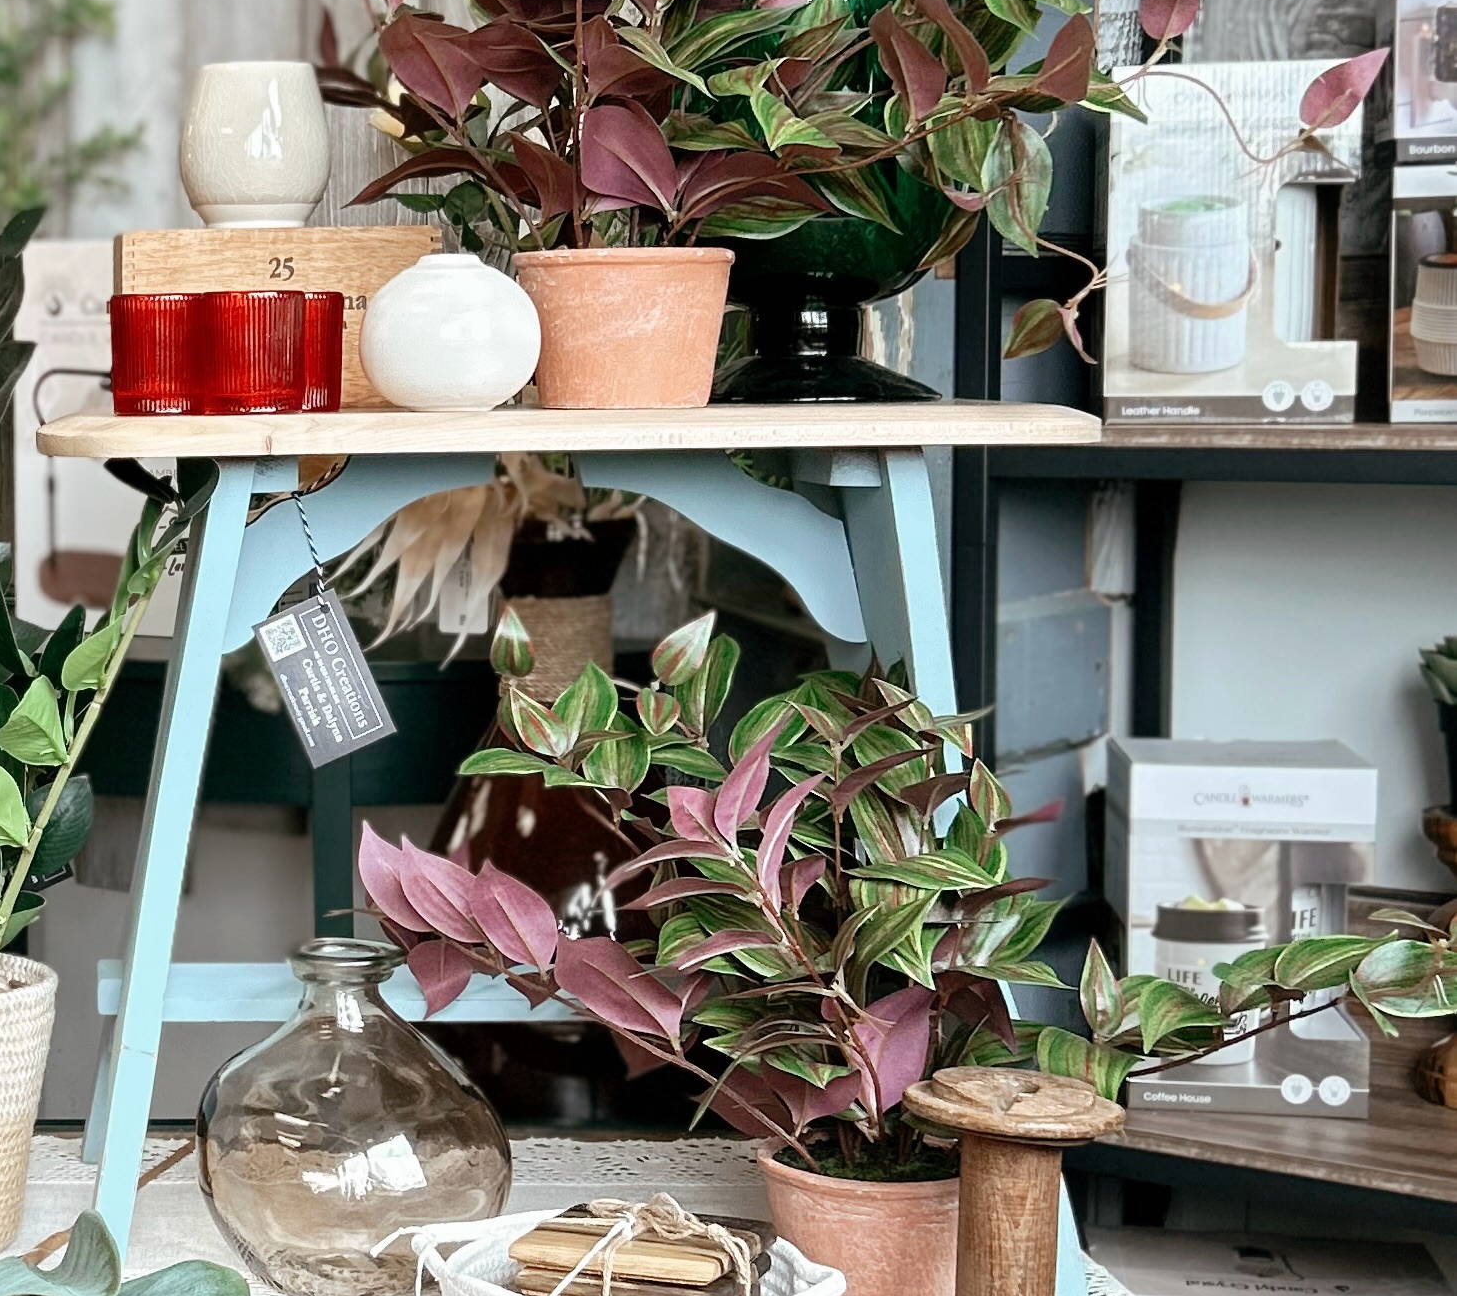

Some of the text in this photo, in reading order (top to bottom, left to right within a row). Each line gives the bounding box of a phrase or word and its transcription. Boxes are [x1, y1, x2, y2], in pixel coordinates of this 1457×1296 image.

[1409, 144, 1456, 155] Bourbon
[268, 256, 296, 282] 25
[1121, 405, 1200, 416] Leather Handle
[311, 613, 339, 655] DHO
[331, 657, 369, 729] Creations
[302, 658, 323, 692] Curtis
[316, 692, 325, 704] &
[1193, 792, 1236, 805] CANDLE
[1292, 906, 1317, 930] IFE
[1167, 967, 1203, 985] LIFE
[1143, 1091, 1212, 1104] Coffee House
